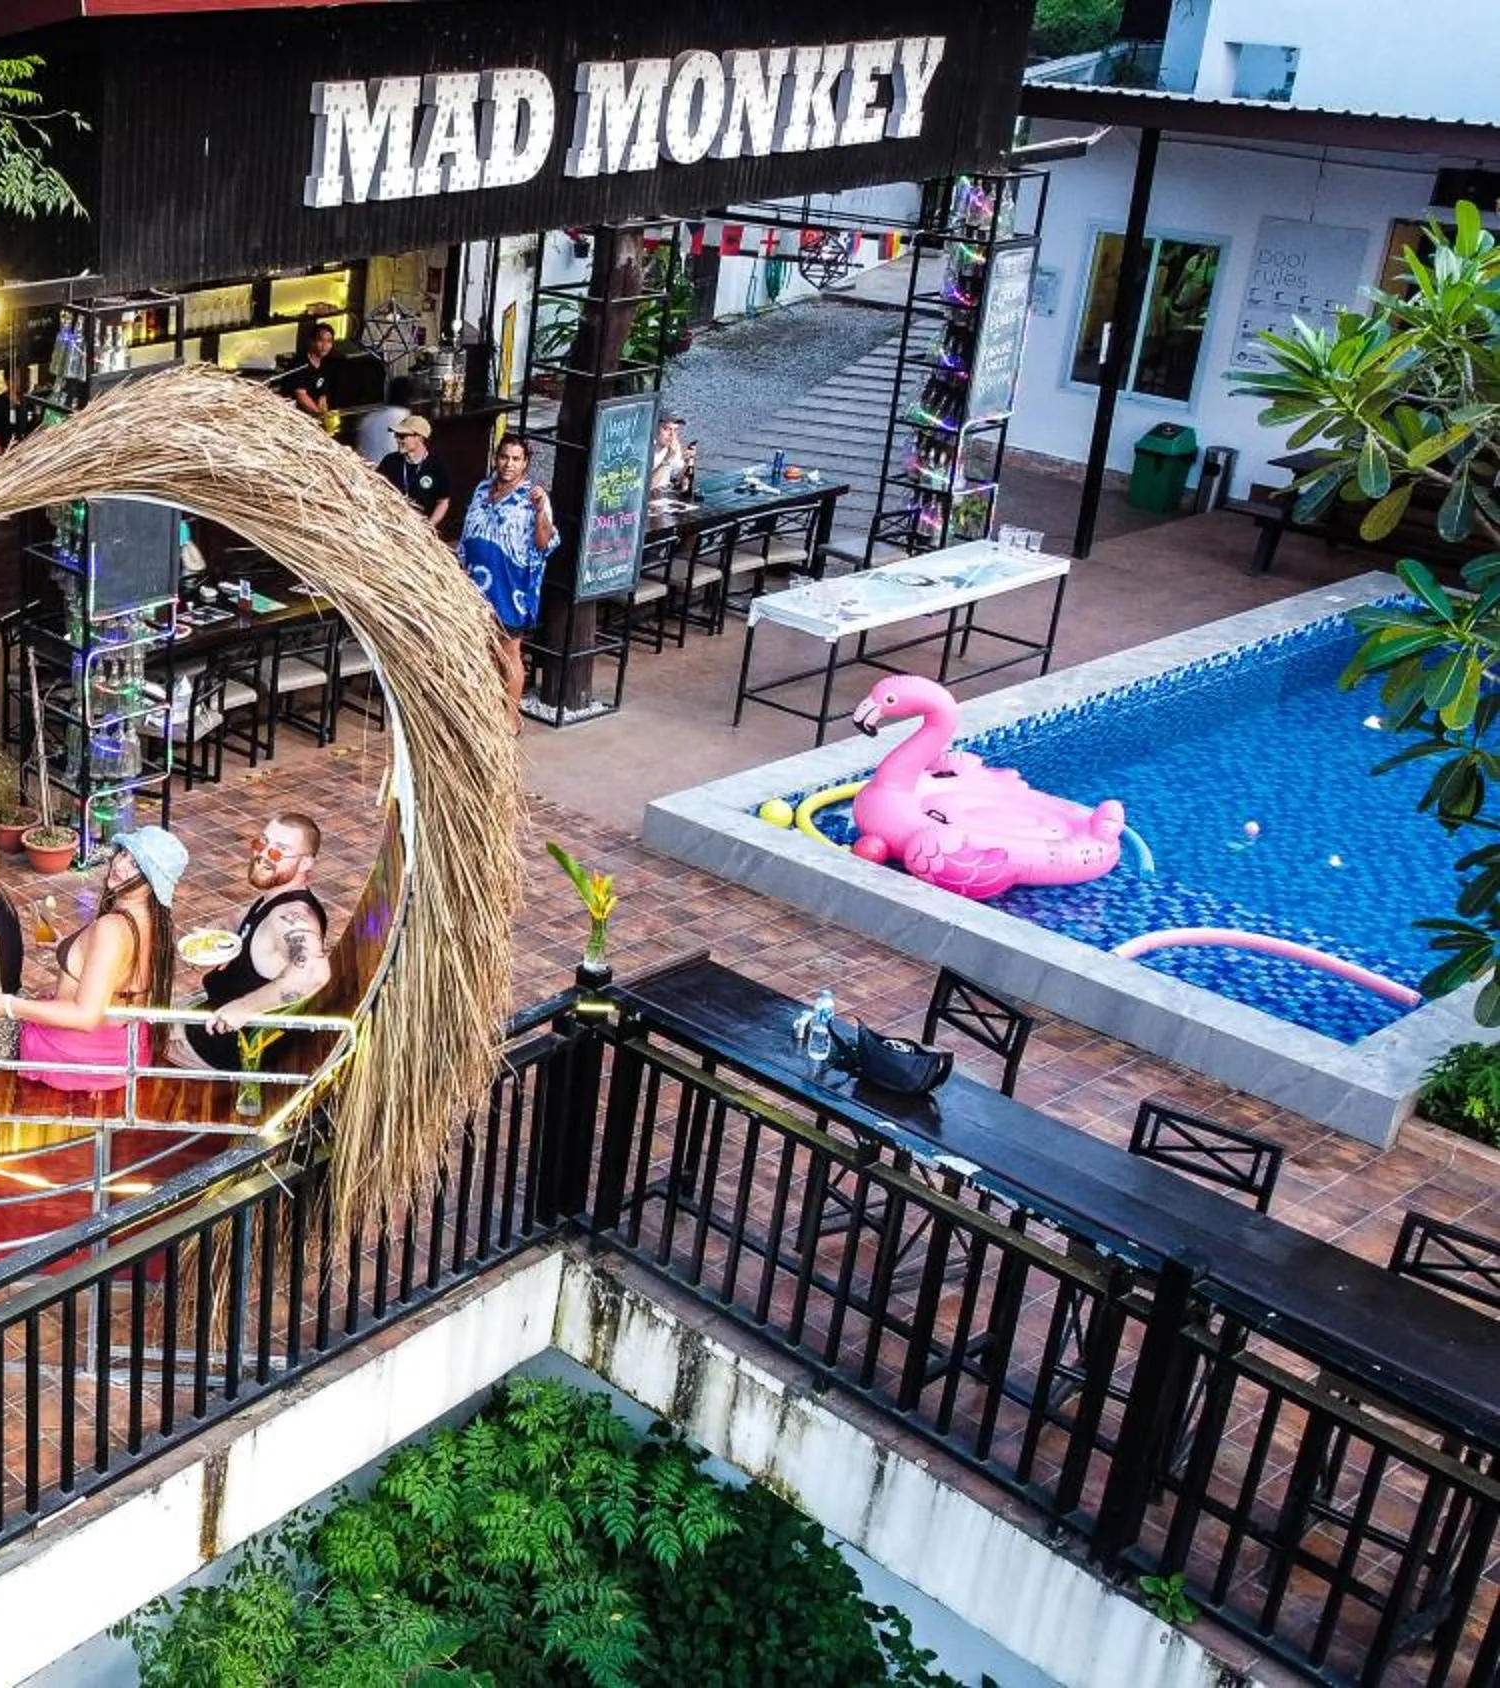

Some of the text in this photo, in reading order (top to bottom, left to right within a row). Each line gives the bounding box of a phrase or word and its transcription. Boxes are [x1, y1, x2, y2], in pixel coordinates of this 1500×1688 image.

[304, 36, 946, 208] MAD MONKEY
[1257, 249, 1308, 269] pool
